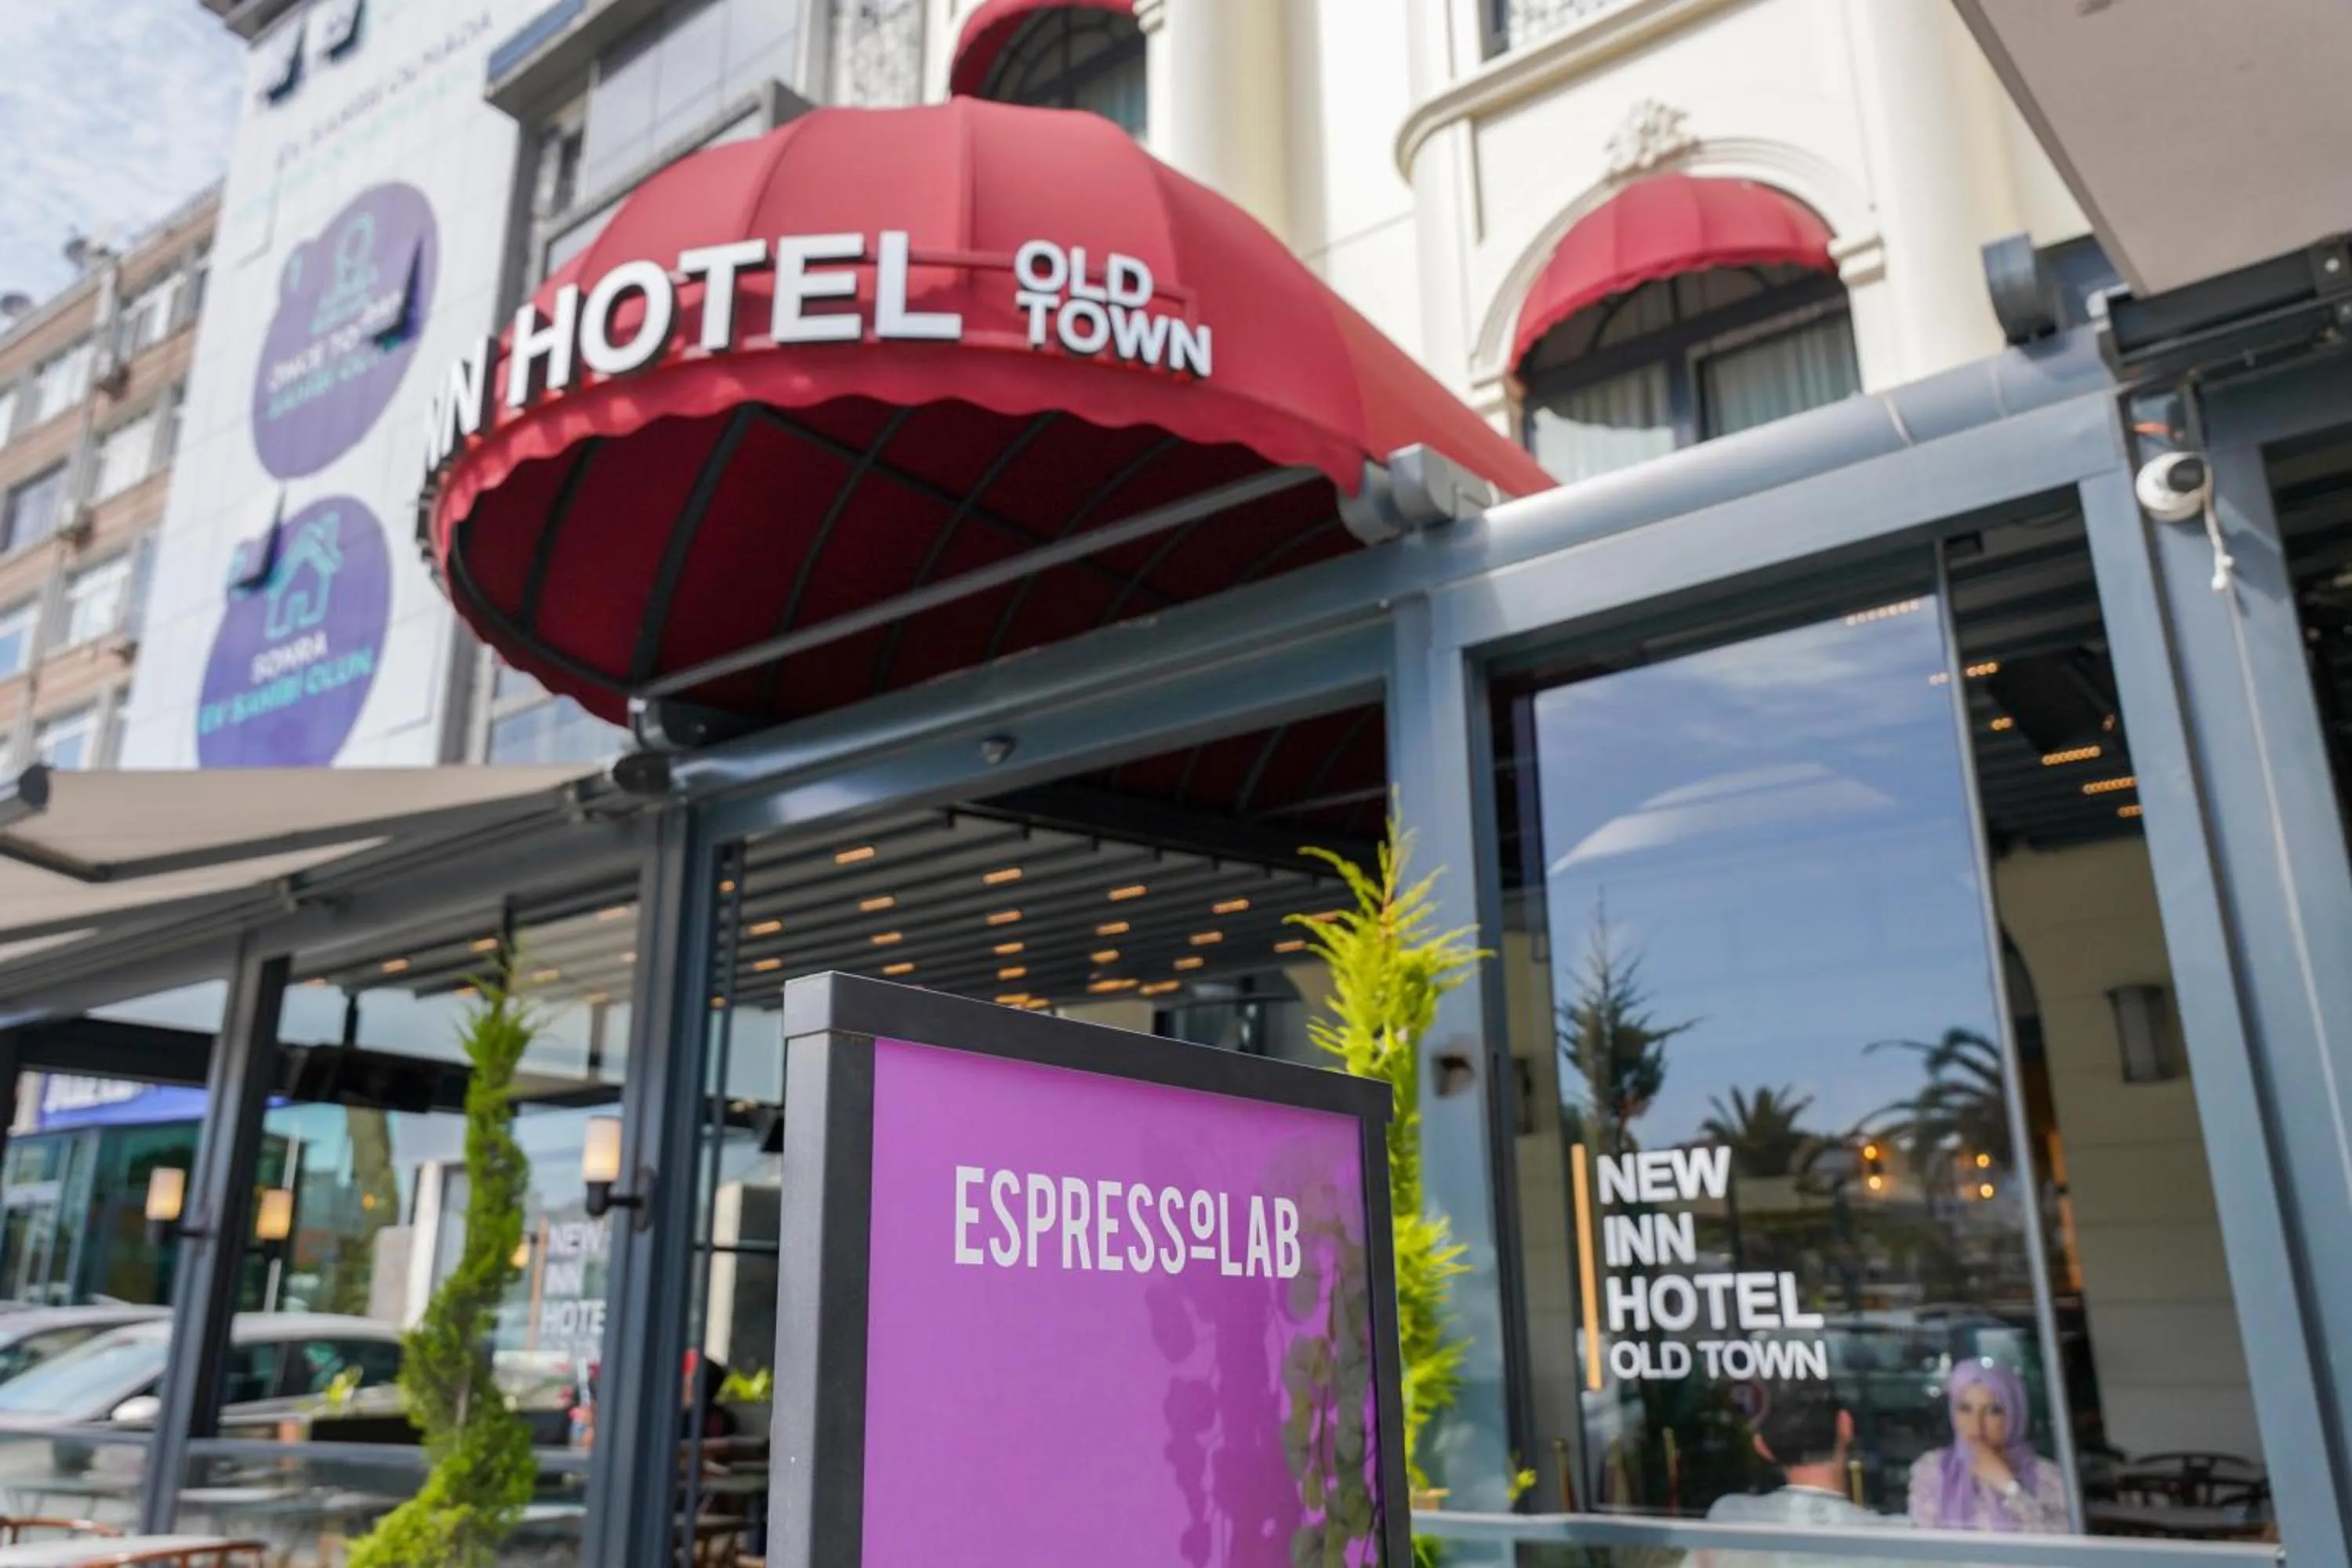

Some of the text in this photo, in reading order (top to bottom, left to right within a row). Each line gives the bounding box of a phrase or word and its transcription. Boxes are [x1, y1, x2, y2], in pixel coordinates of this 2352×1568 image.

[1014, 240, 1153, 309] OLD
[506, 230, 963, 408] HOTEL
[1015, 289, 1212, 378] TOWN
[1596, 1145, 1731, 1204] NEW
[1603, 1212, 1697, 1267] INN
[1605, 1272, 1824, 1331] HOTEL
[1610, 1340, 1828, 1381] OLD TOWN
